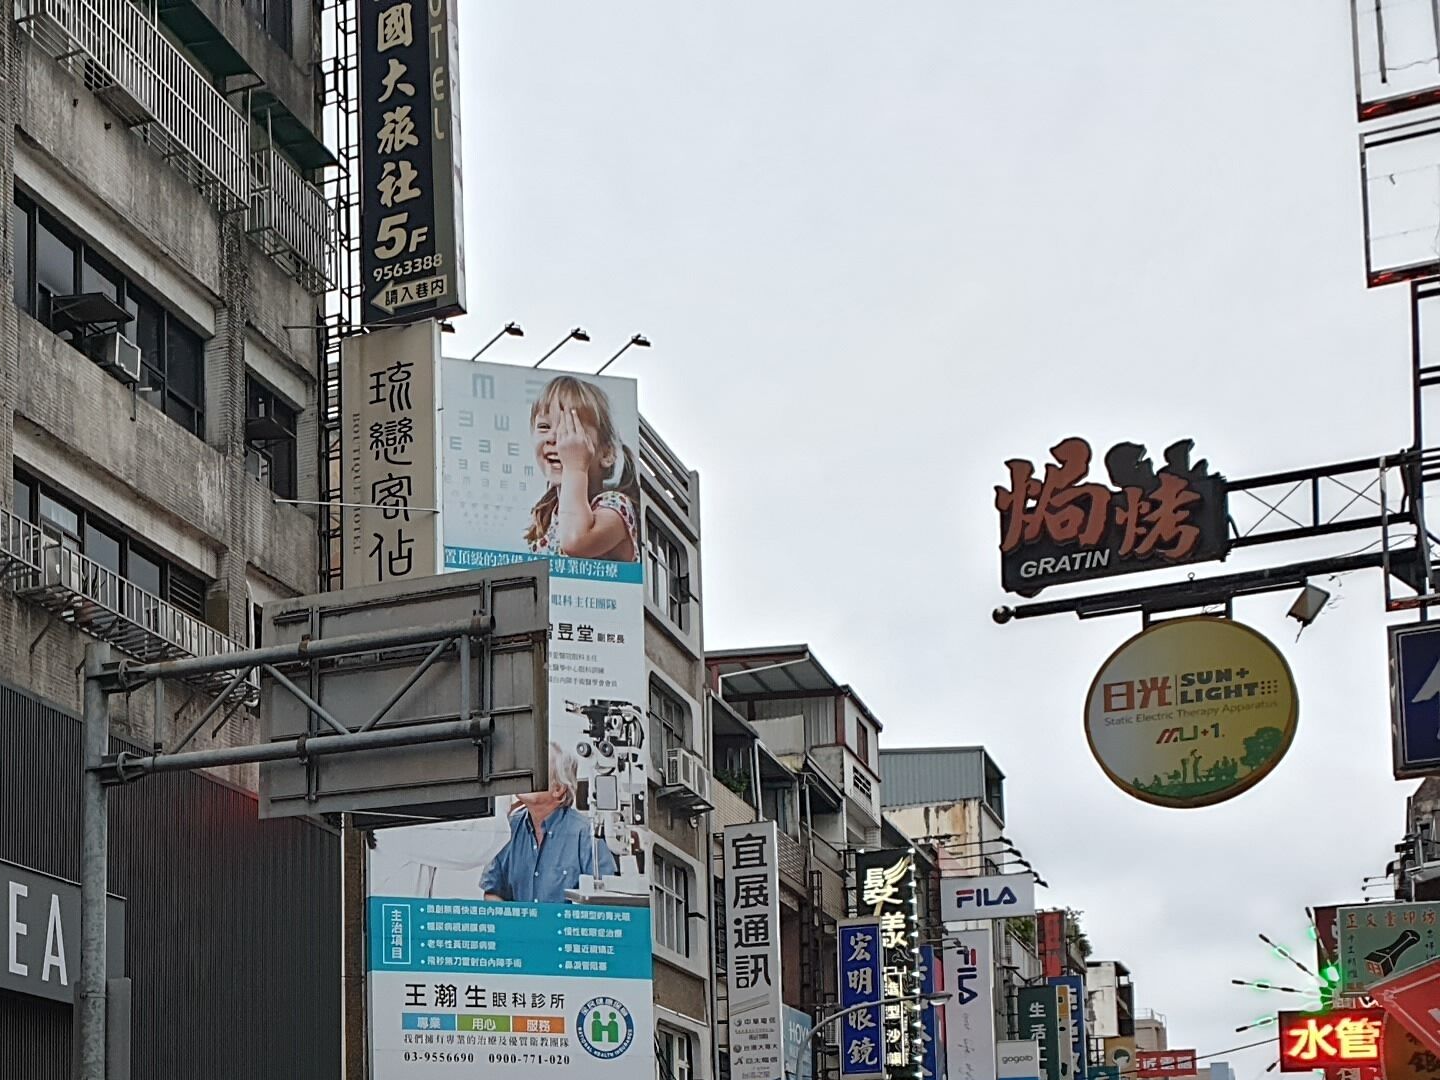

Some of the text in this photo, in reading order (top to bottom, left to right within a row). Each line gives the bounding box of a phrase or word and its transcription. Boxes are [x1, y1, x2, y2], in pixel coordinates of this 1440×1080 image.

[377, 3, 422, 207] 國大旅社
[374, 212, 428, 260] 5F
[373, 253, 443, 282] 9563388
[385, 278, 445, 306] 請入巷內
[1020, 549, 1110, 578] GRATIN
[1103, 676, 1172, 713] 日光
[1180, 681, 1259, 704] LIGHT
[1104, 701, 1279, 727] Static Electric Therapy Apparatus
[732, 833, 772, 988] 宜展通訊
[956, 886, 1017, 908] FILA
[391, 909, 403, 959] 主治項目
[956, 948, 978, 1005] FILA
[405, 983, 565, 1010] 王瀚生眼科診所
[847, 932, 878, 1065] 宏明眼鏡
[472, 1018, 497, 1031] 用心
[526, 1019, 551, 1032] 服務
[1288, 1018, 1382, 1060] 水管
[404, 1052, 570, 1065] 03-9556690 0900-771-020
